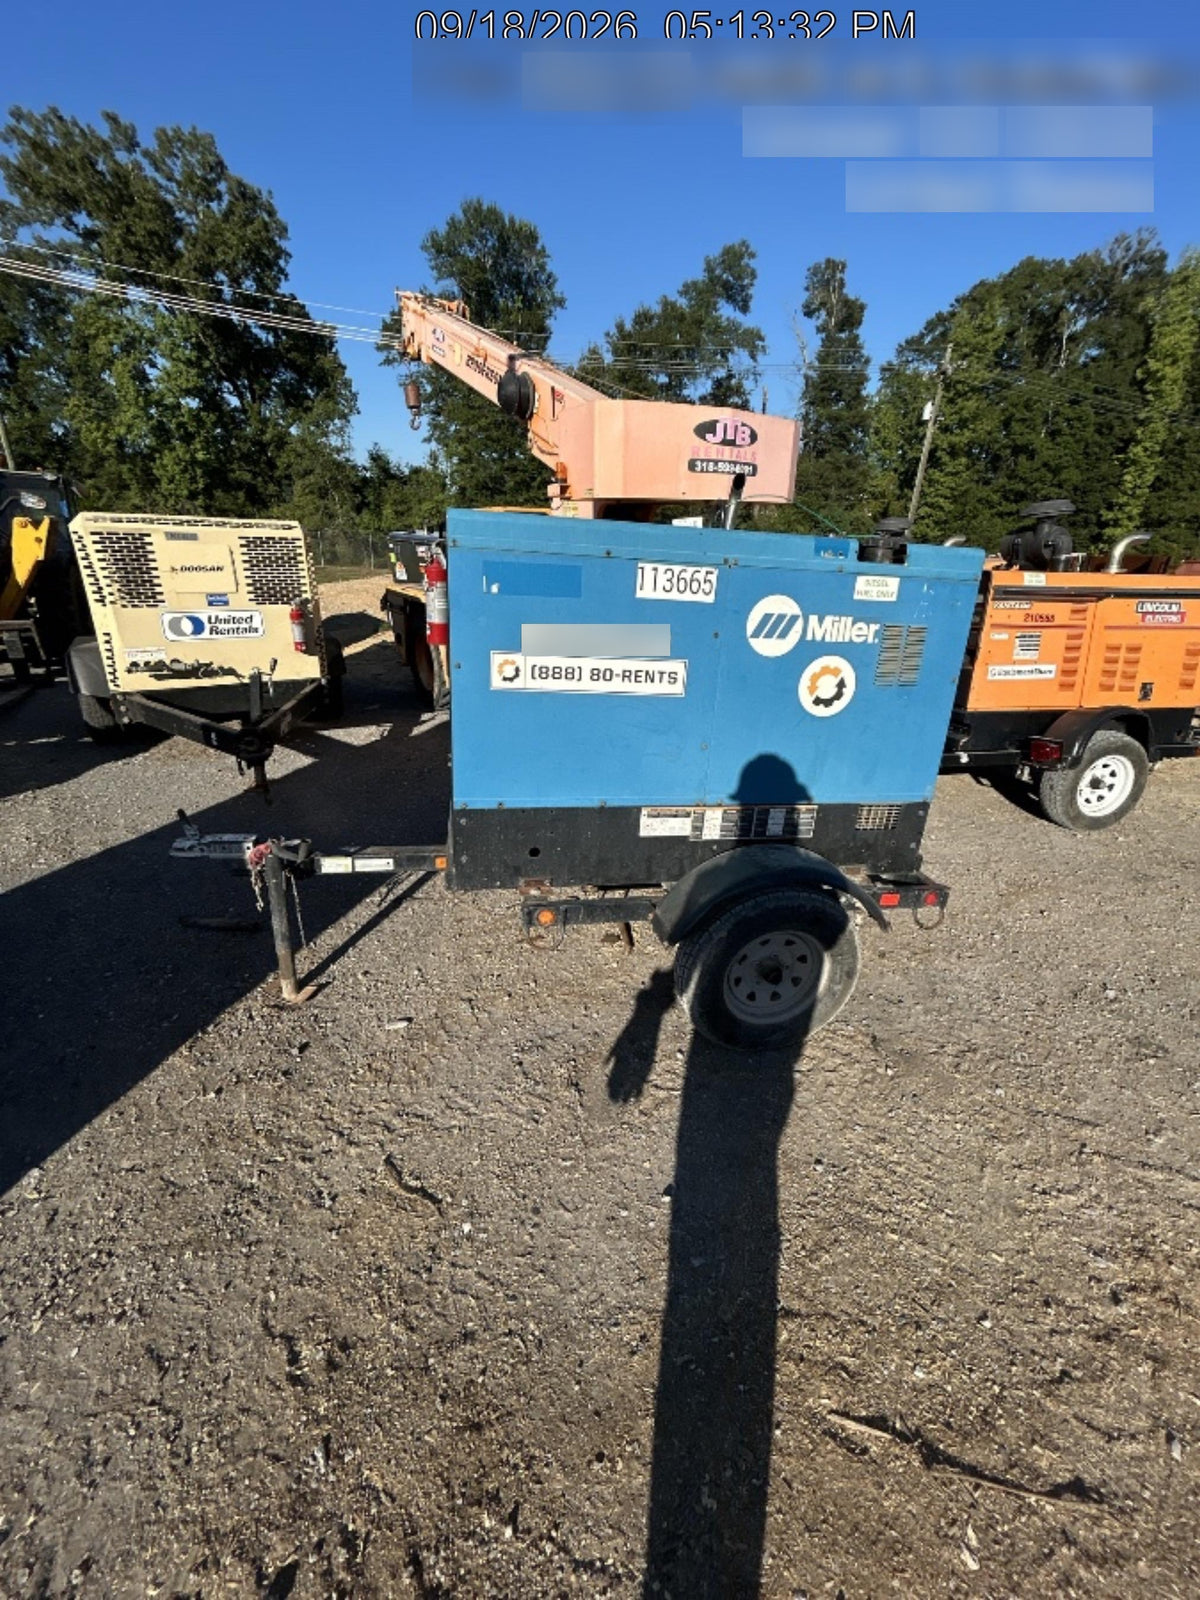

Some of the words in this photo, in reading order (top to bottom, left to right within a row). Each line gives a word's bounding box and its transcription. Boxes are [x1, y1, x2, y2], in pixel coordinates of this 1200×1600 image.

[705, 417, 751, 445] JTB
[690, 446, 757, 463] RENTALS
[180, 564, 225, 573] DOOSAN
[638, 566, 714, 596] 113665
[207, 614, 253, 625] United
[209, 625, 259, 635] Rentals
[531, 664, 582, 682] (888)
[589, 667, 679, 685] 80-RENTS
